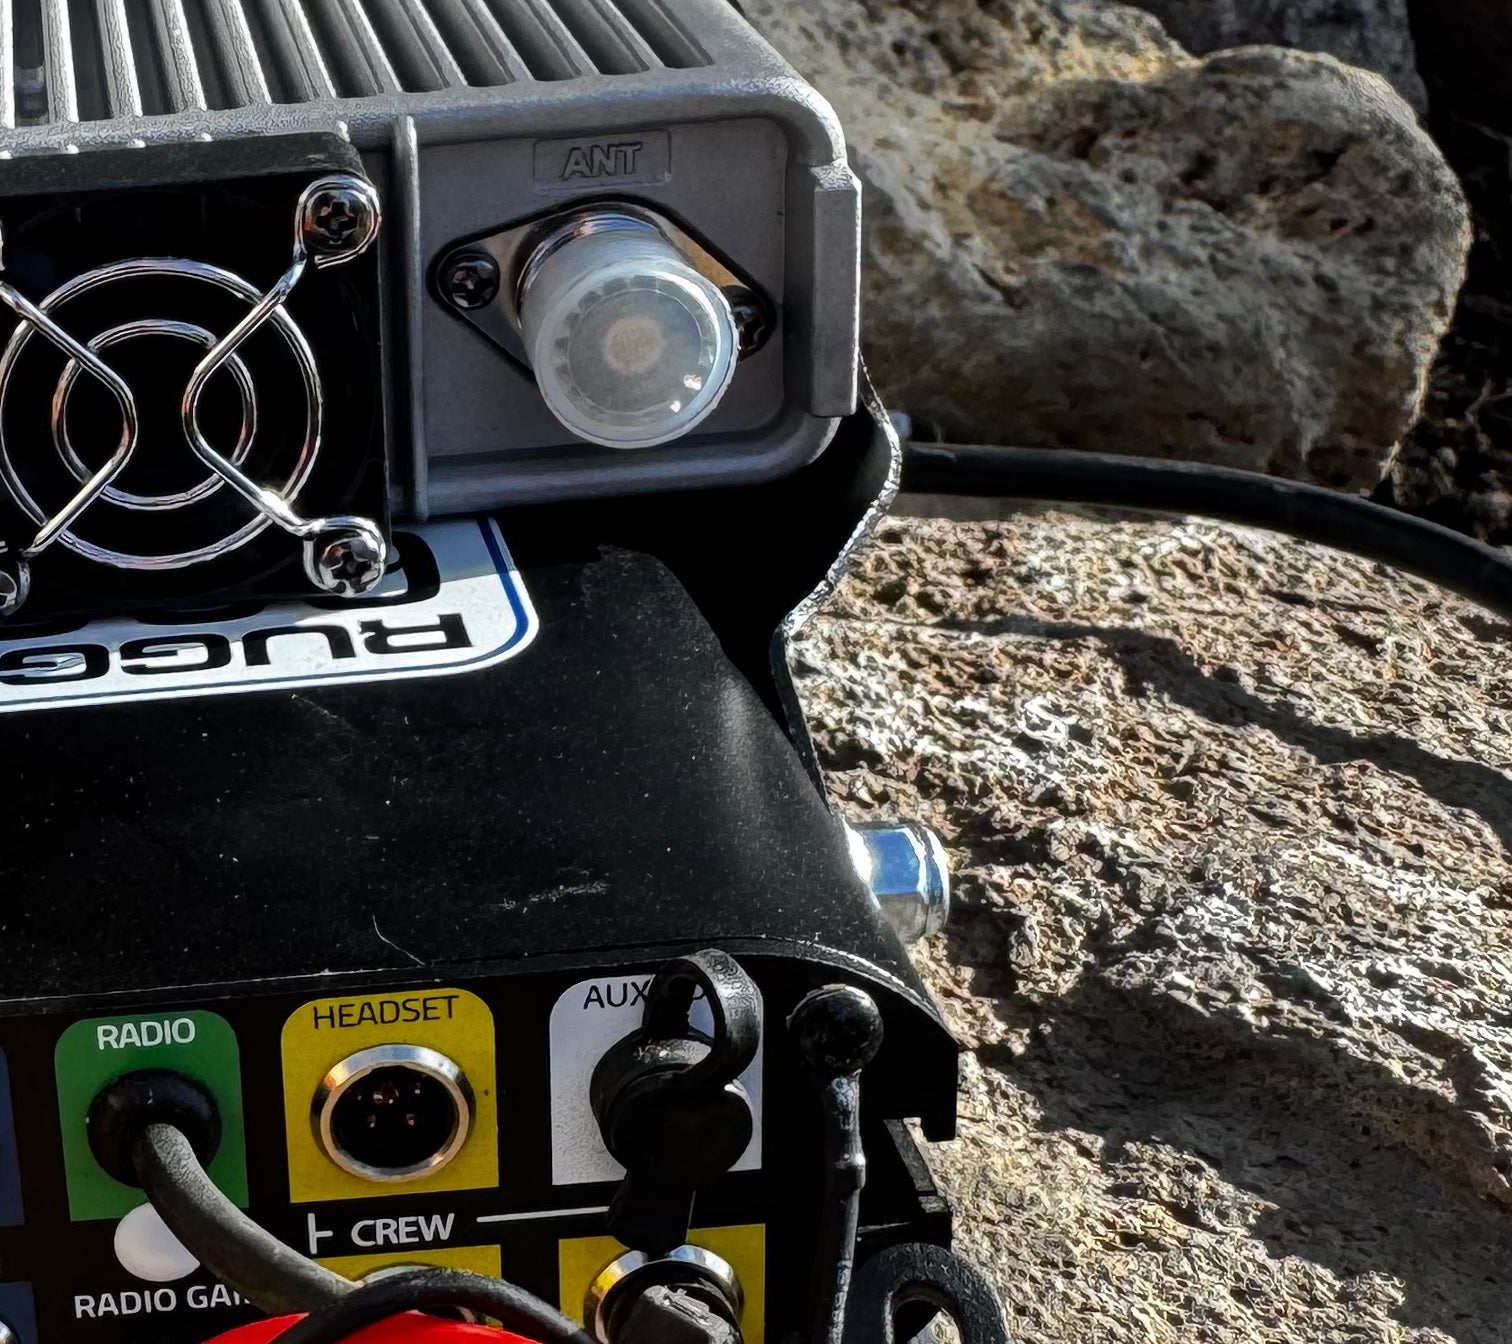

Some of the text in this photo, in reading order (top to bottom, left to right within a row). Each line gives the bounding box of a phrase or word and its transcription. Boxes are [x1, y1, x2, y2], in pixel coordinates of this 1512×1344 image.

[560, 141, 643, 180] ANT
[313, 994, 460, 1030] HEADSET
[96, 1017, 196, 1051] RADIO
[351, 1213, 455, 1248] CREW
[74, 1283, 251, 1318] RADIO GAI
